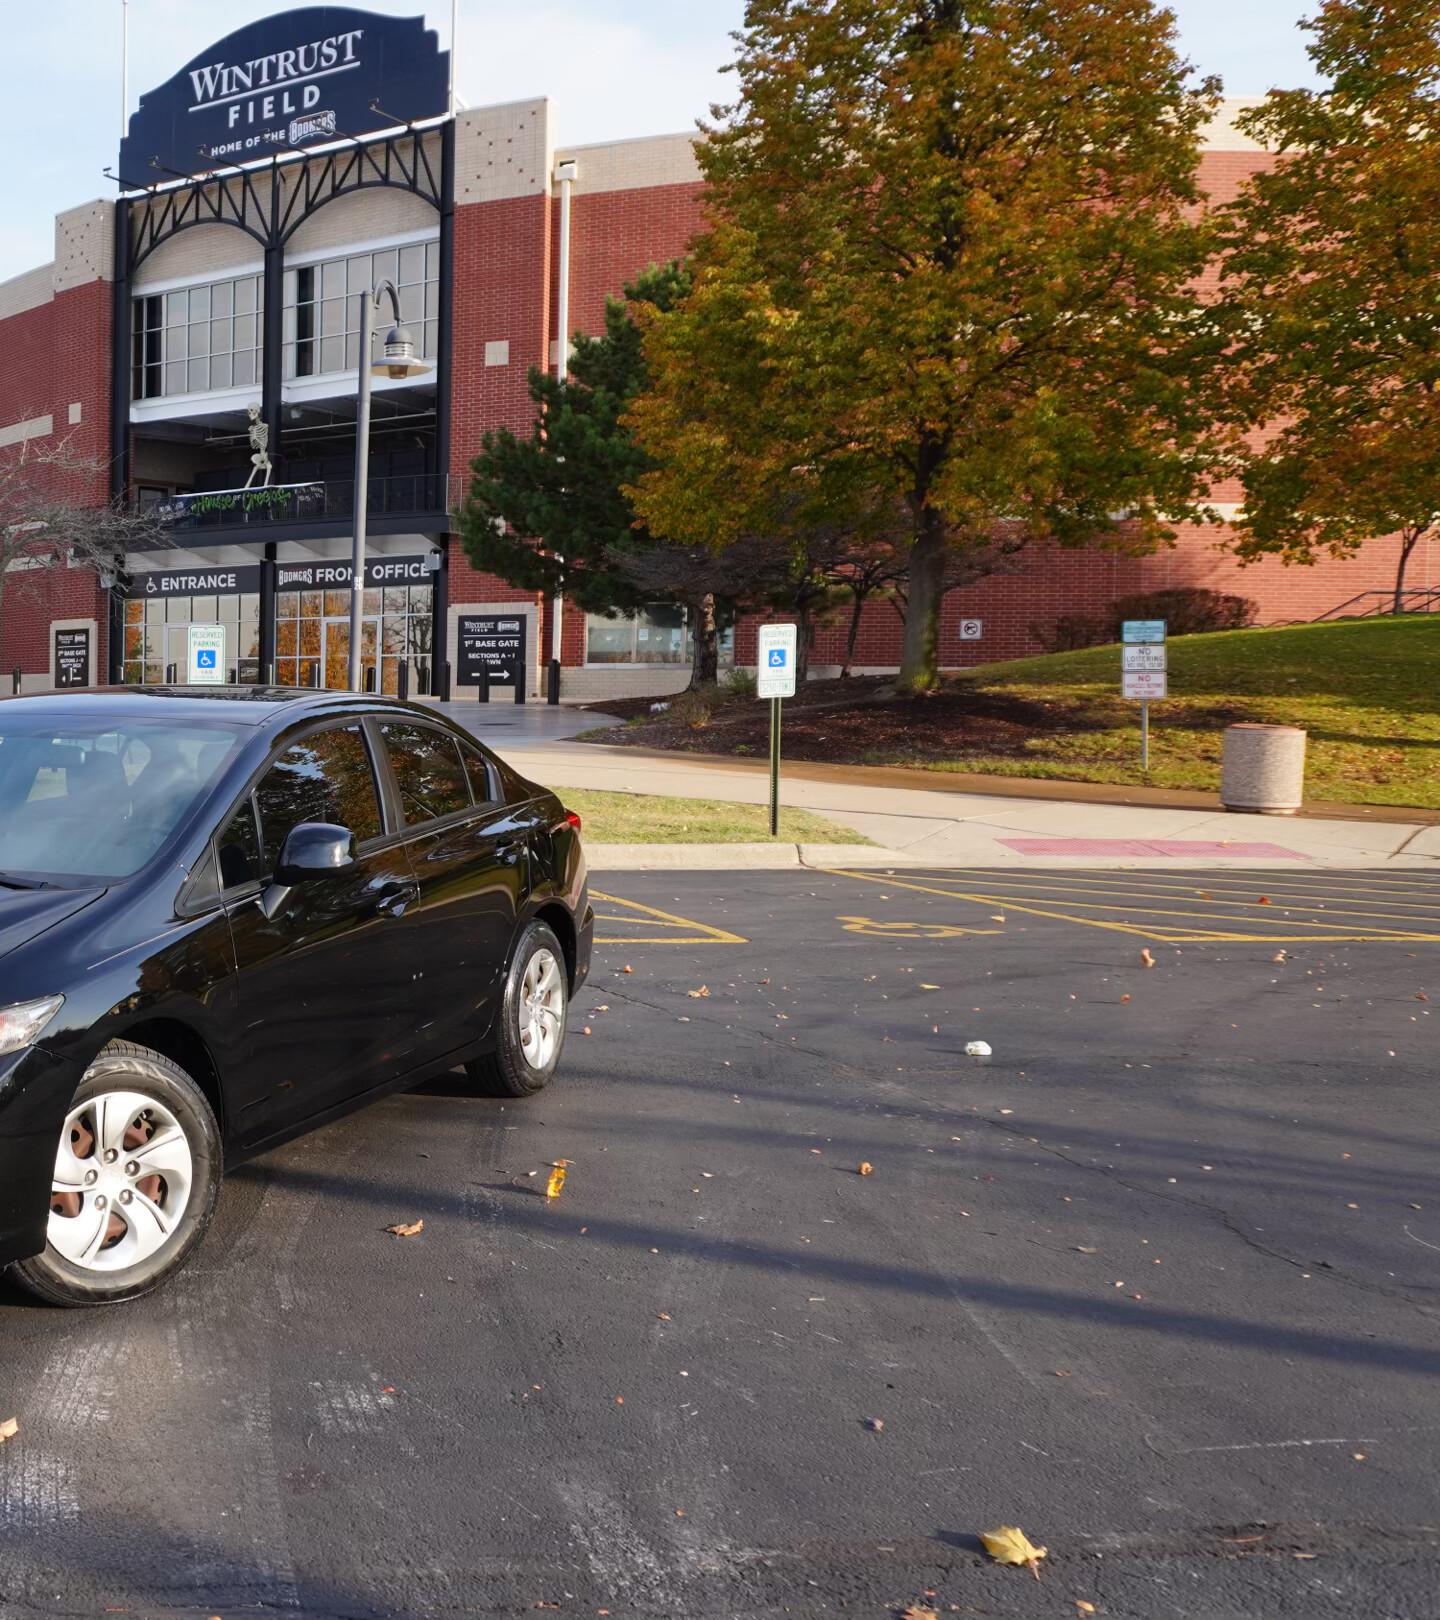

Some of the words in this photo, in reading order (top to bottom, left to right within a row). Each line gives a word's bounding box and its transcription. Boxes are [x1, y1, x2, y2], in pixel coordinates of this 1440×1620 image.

[189, 30, 364, 102] WINTRUST
[228, 85, 321, 128] FIELD
[211, 141, 242, 156] HOME
[246, 136, 261, 148] OF
[161, 573, 236, 591] ENTRANCE
[278, 568, 312, 586] BOOMERS
[315, 565, 368, 583] FRO
[372, 563, 430, 580] OFFICE
[475, 640, 497, 648] BASE
